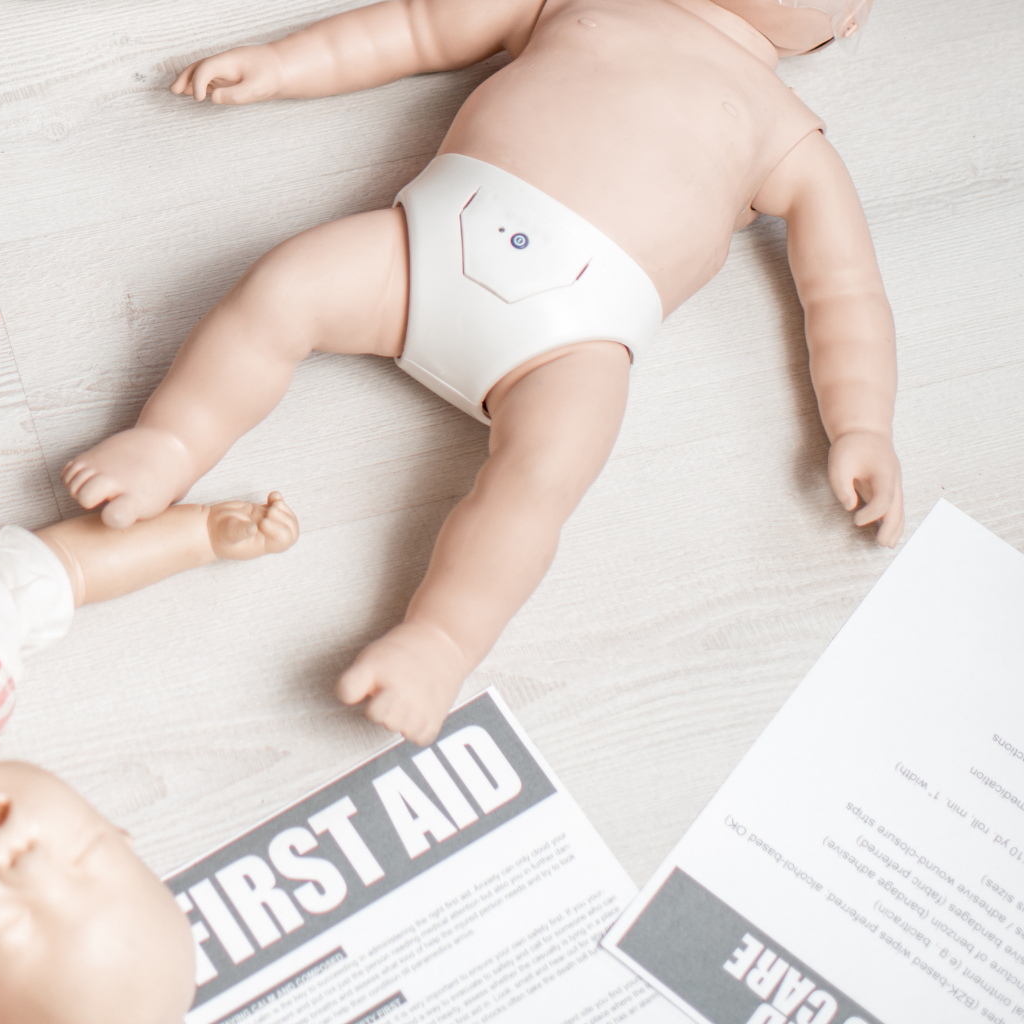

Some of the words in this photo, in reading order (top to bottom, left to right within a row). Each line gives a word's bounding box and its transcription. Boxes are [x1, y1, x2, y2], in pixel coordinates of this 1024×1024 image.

[894, 761, 927, 789] width)
[724, 814, 746, 836] OK)
[846, 802, 875, 826] strips
[174, 795, 386, 987] FIRST
[372, 725, 523, 860] AID
[747, 833, 823, 891] alcohol-based
[822, 836, 875, 878] adhesive)
[856, 835, 911, 878] preferred)
[876, 825, 954, 885] wound-closure
[877, 877, 929, 919] (bandage
[911, 876, 946, 905] (fabric
[956, 884, 1006, 922] adhesive
[980, 874, 1014, 903] sizes)
[873, 900, 931, 948] bacitracin)
[878, 931, 910, 958] wipes
[930, 916, 974, 954] benzoin
[948, 903, 1002, 948] bandages
[973, 950, 987, 961] of
[250, 993, 277, 1013] CALM
[275, 982, 295, 998] AND
[294, 953, 344, 986] COMPOSED
[722, 932, 838, 1024] CARE
[910, 956, 979, 1010] (BZK-based
[961, 967, 1011, 1006] ointment
